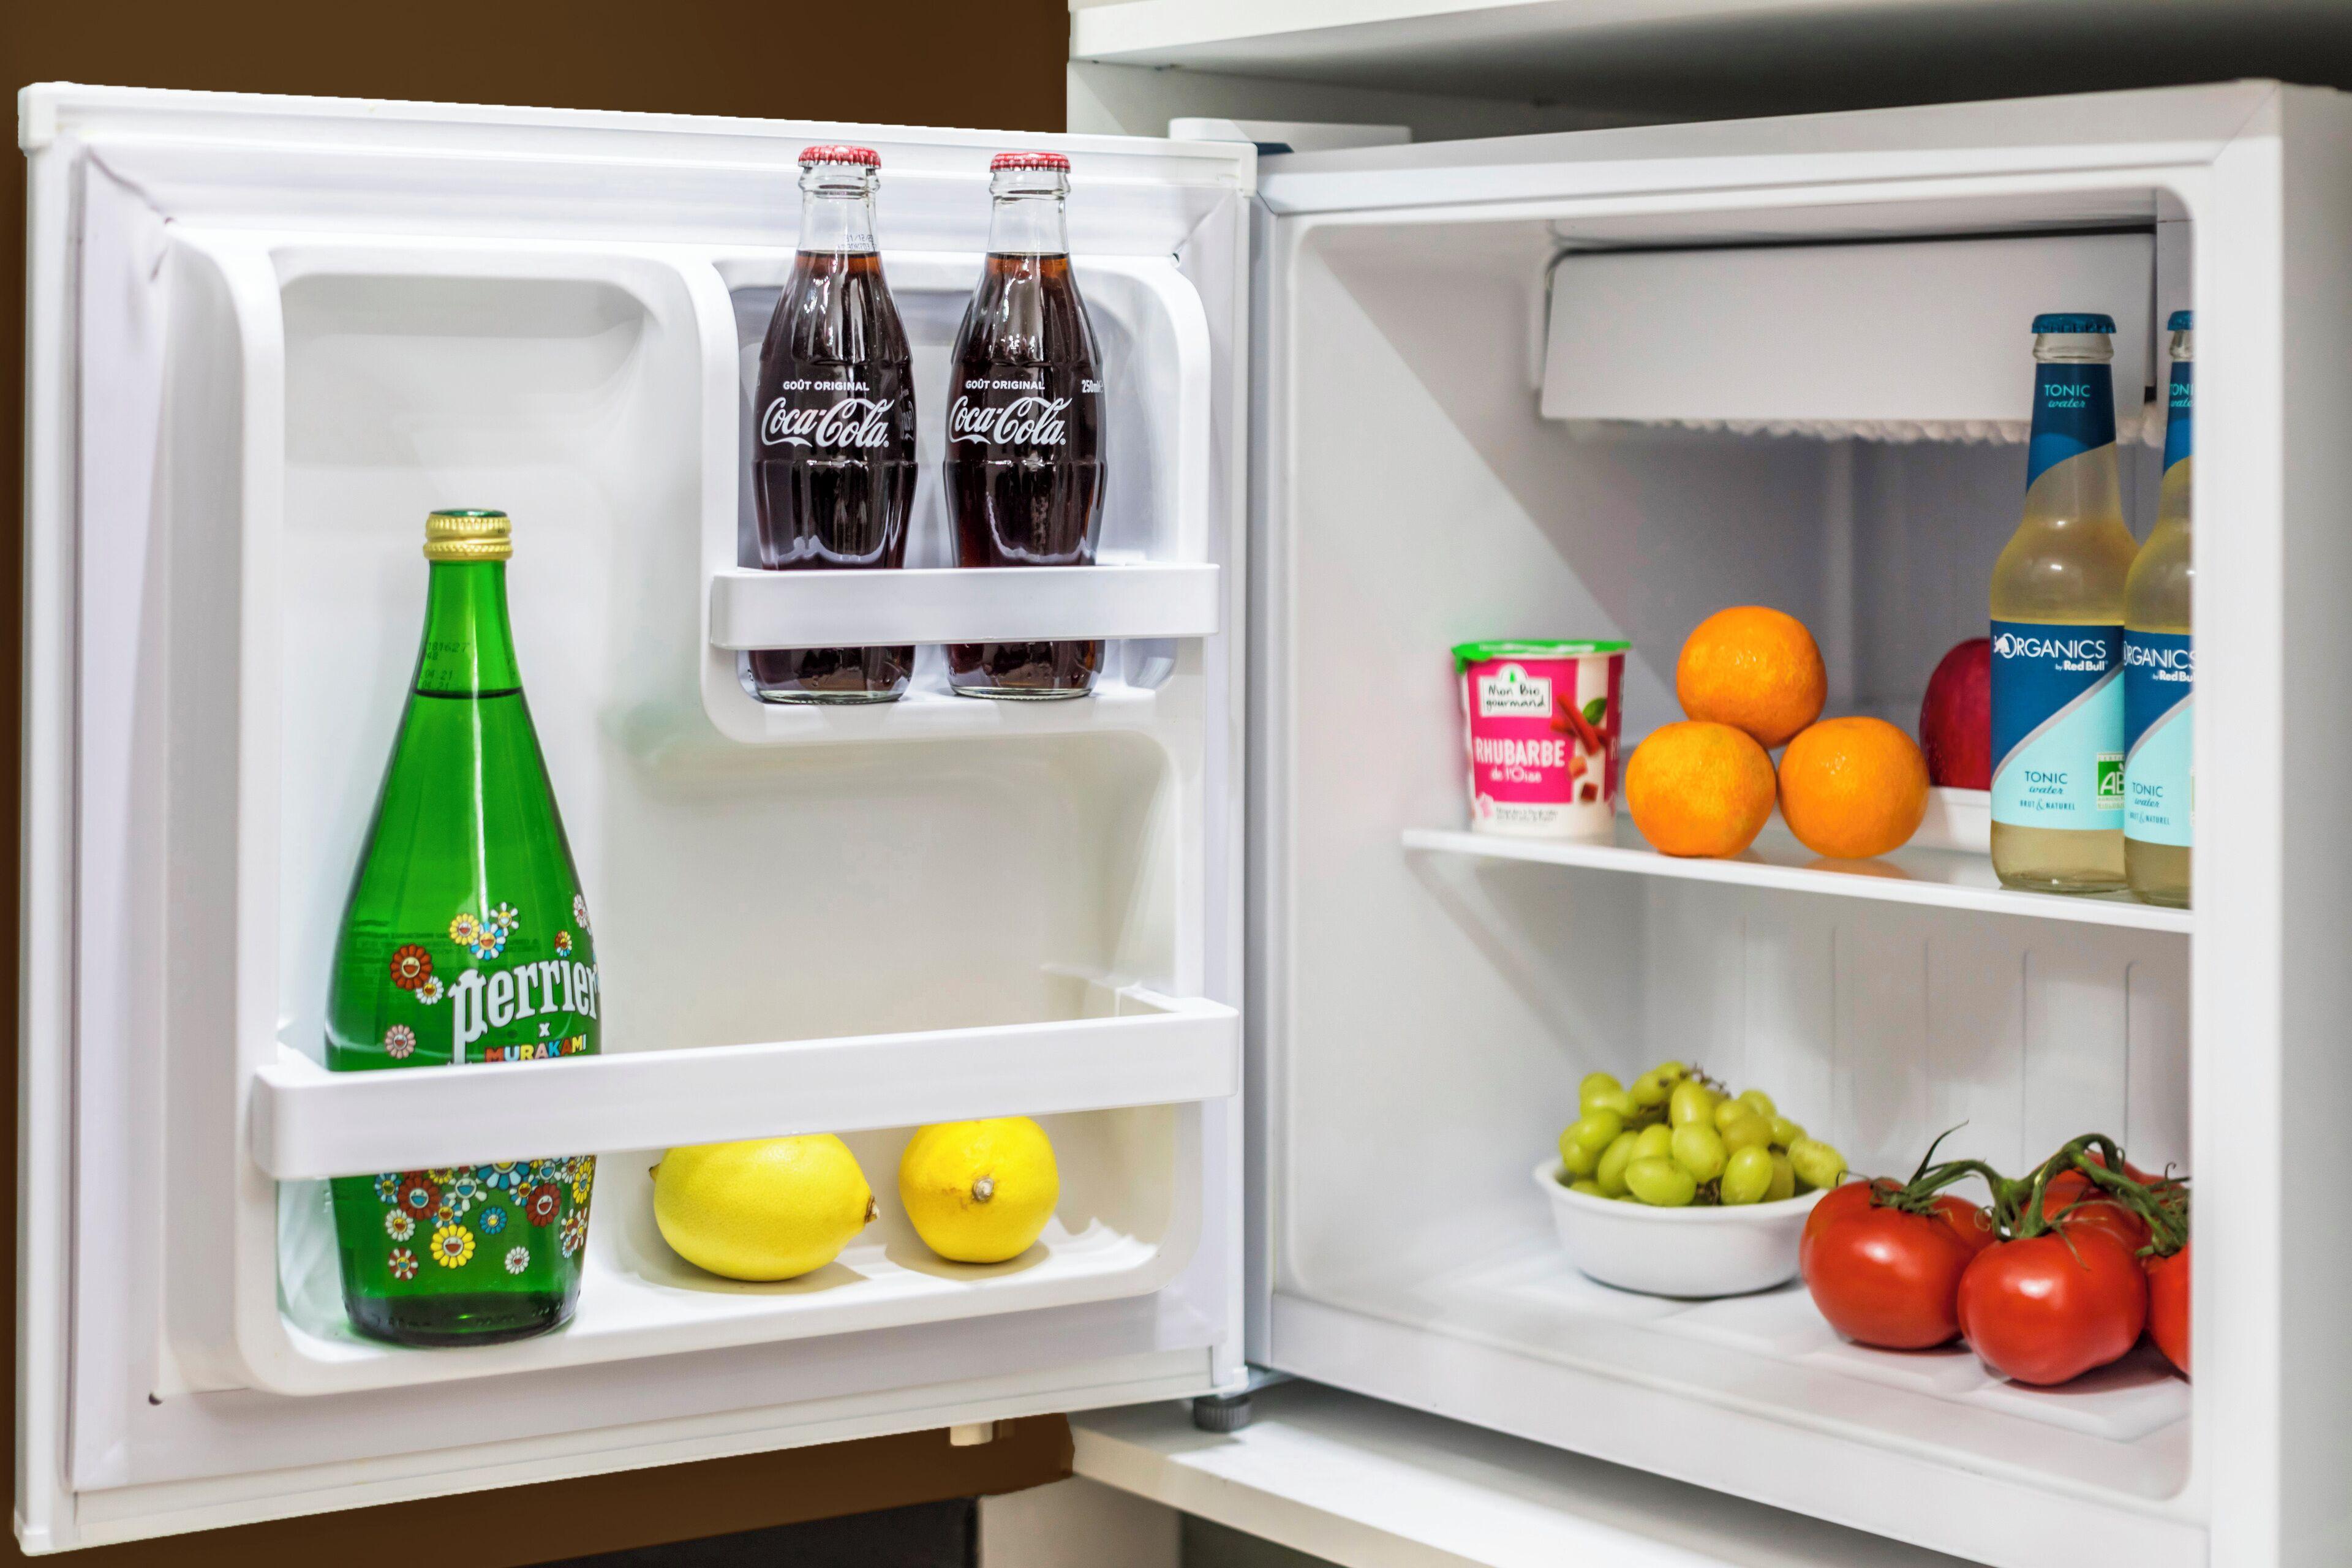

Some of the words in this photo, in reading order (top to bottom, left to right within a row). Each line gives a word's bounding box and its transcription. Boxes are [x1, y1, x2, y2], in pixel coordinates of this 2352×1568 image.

[783, 379, 812, 391] GOÛT
[813, 380, 870, 391] ORIGINAL
[965, 378, 990, 390] GOÛT
[992, 380, 1046, 390] ORIGINAL
[2044, 384, 2091, 397] TONIC
[2048, 398, 2086, 408] water
[761, 397, 895, 448] Coca-Cola
[948, 395, 1073, 445] Coca-Cola
[2000, 632, 2107, 660] ORGANICS
[2063, 660, 2084, 671] Red
[2086, 660, 2105, 671] Bull
[2159, 669, 2178, 681] Red
[1519, 682, 1540, 696] Bio
[1486, 694, 1545, 712] gourmand
[1474, 736, 1566, 768] RHUBARBE
[2024, 771, 2068, 785] TONIC
[2029, 785, 2064, 795] water
[2132, 782, 2164, 798] TONIC
[2135, 797, 2160, 809] water
[485, 1033, 587, 1063] MURAKAMI
